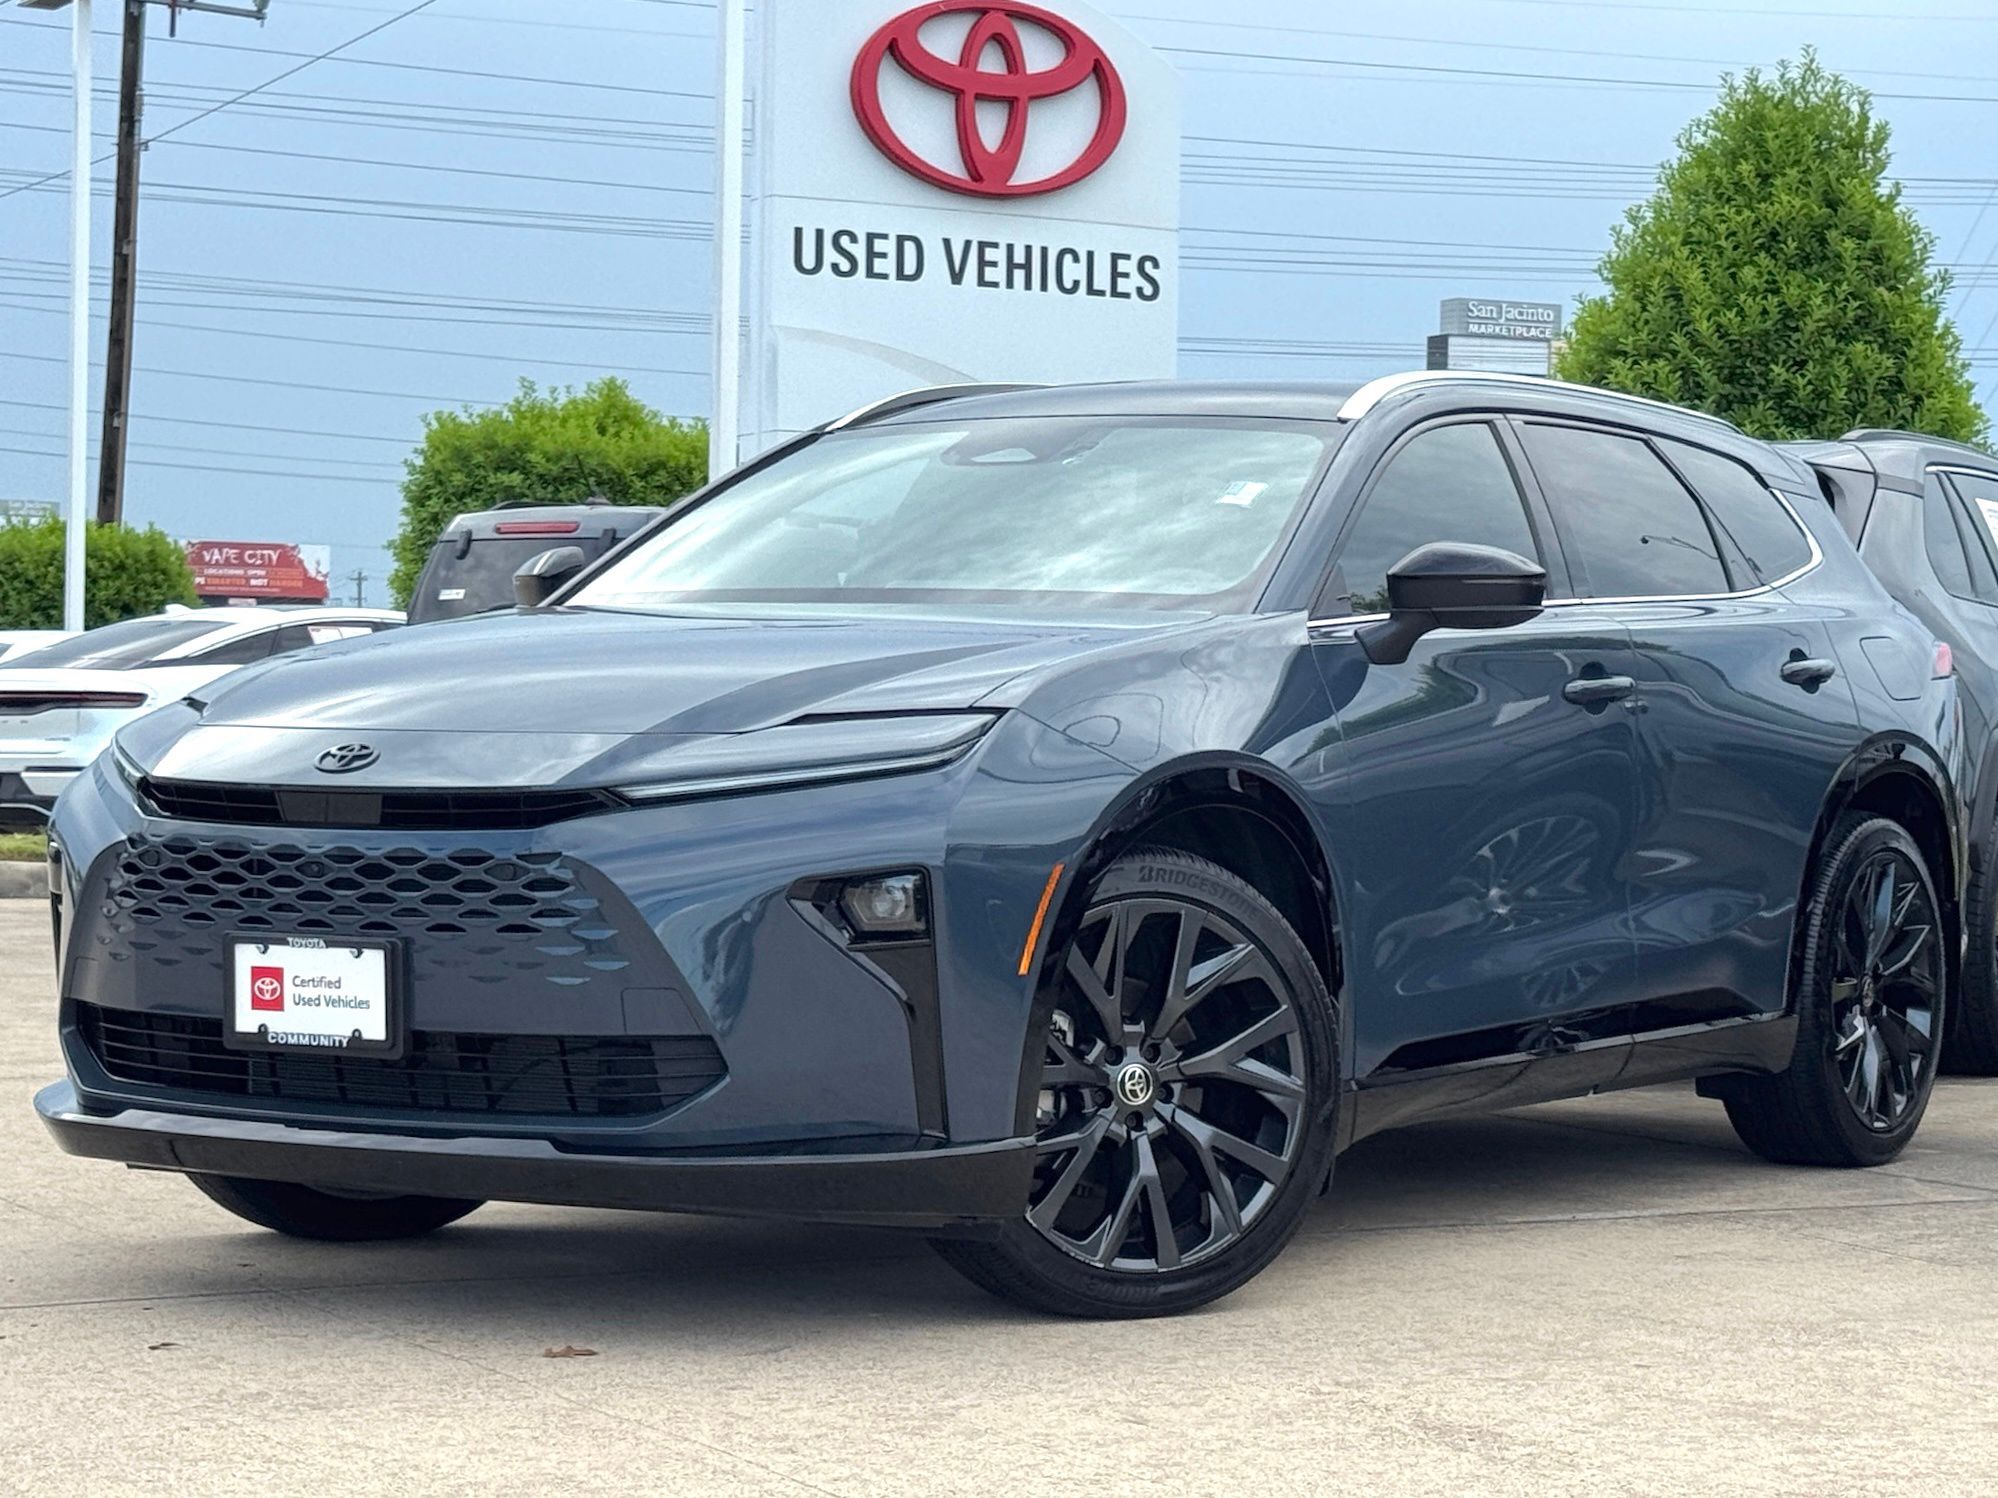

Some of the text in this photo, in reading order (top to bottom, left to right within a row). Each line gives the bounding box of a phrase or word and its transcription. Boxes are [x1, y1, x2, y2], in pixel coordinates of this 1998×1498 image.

[793, 226, 1160, 302] USED VEHICLES
[1467, 301, 1554, 322] San Jacinto
[1467, 323, 1553, 338] MARKETPLACE
[202, 547, 281, 566] VAPE CITY
[1137, 864, 1259, 921] BRIDGESTONE
[286, 937, 327, 949] TOYOTA
[292, 975, 342, 990] Certified
[292, 993, 370, 1010] Used Vehicles
[267, 1031, 350, 1048] COMMUNITY
